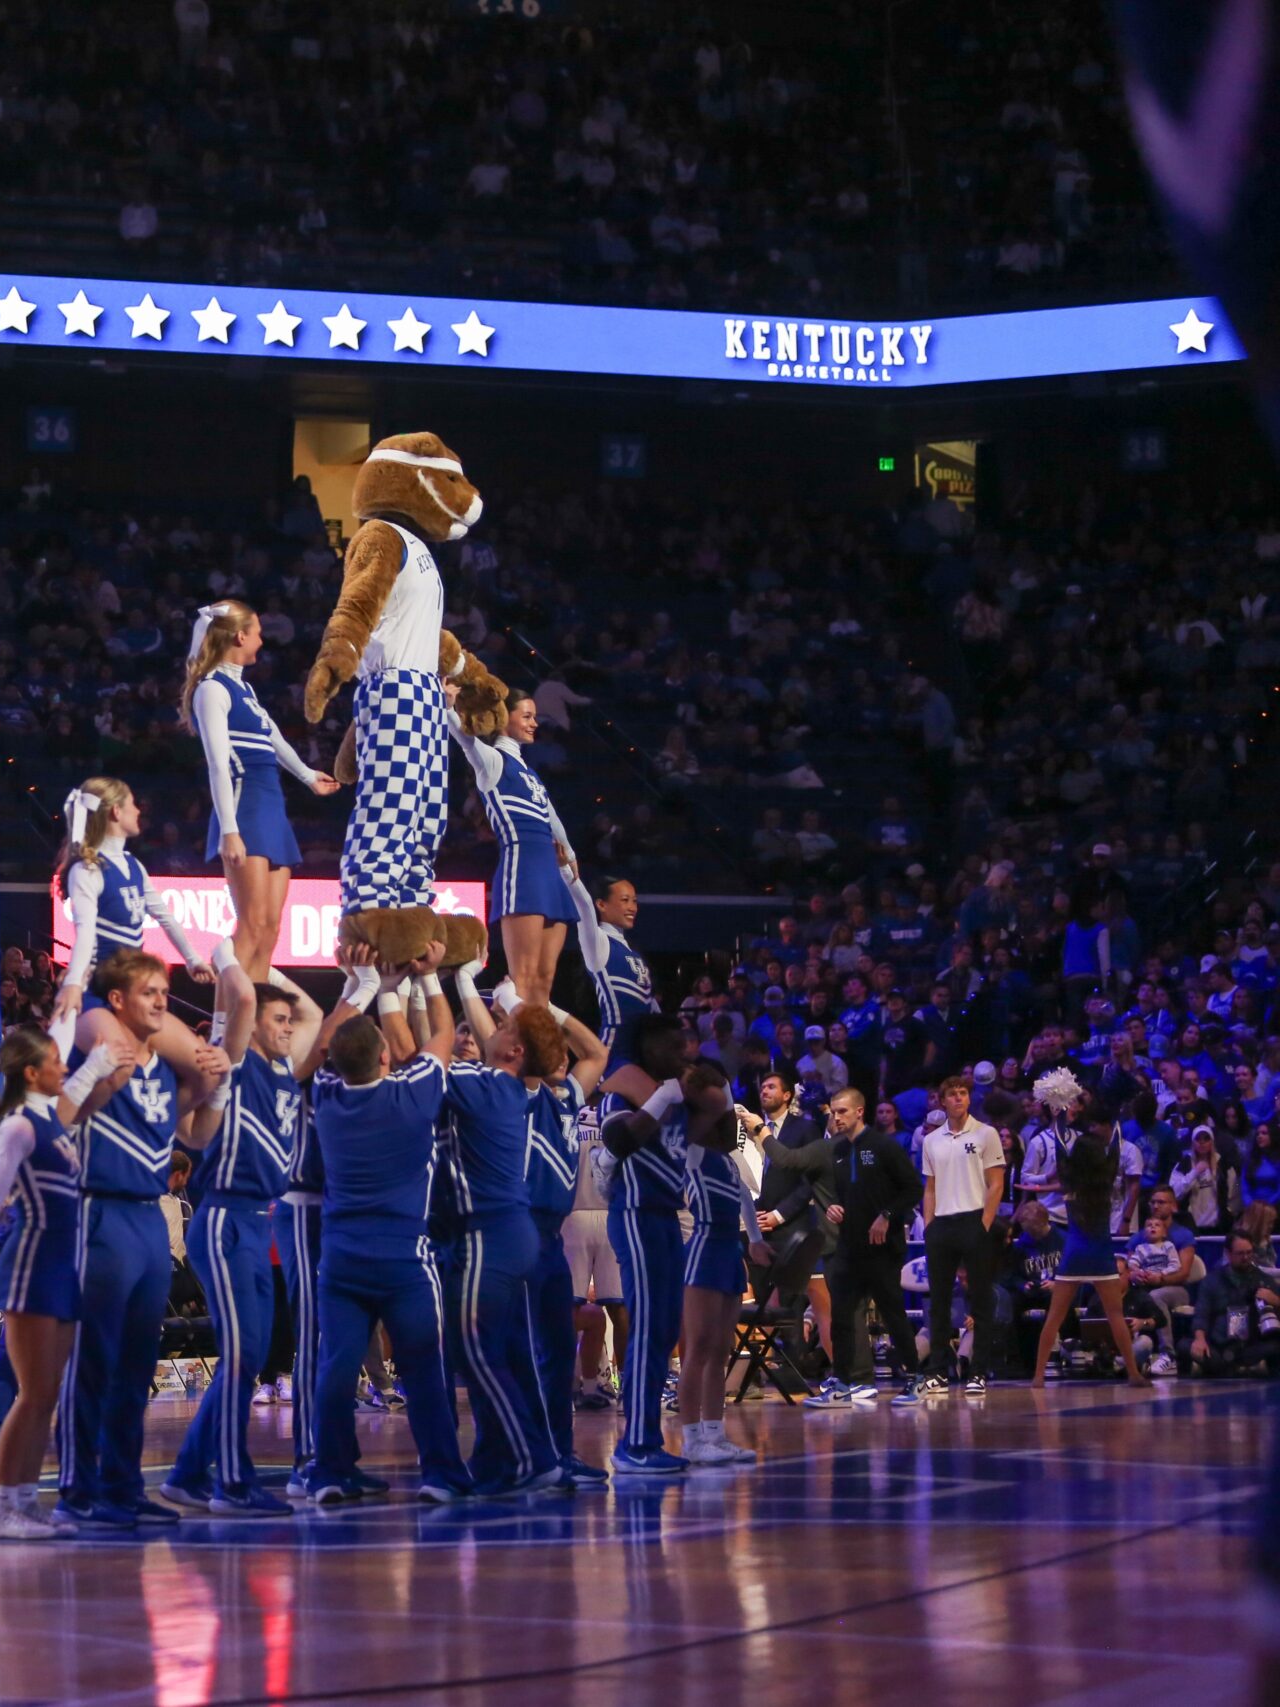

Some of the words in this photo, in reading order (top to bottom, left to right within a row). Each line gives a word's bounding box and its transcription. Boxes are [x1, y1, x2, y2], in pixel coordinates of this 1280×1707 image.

[724, 319, 933, 366] KENTUCKY
[767, 363, 892, 382] BASKETBALL
[34, 416, 70, 442] 36
[129, 1078, 172, 1123] UK
[275, 1089, 303, 1137] UK
[964, 1143, 976, 1154] UK
